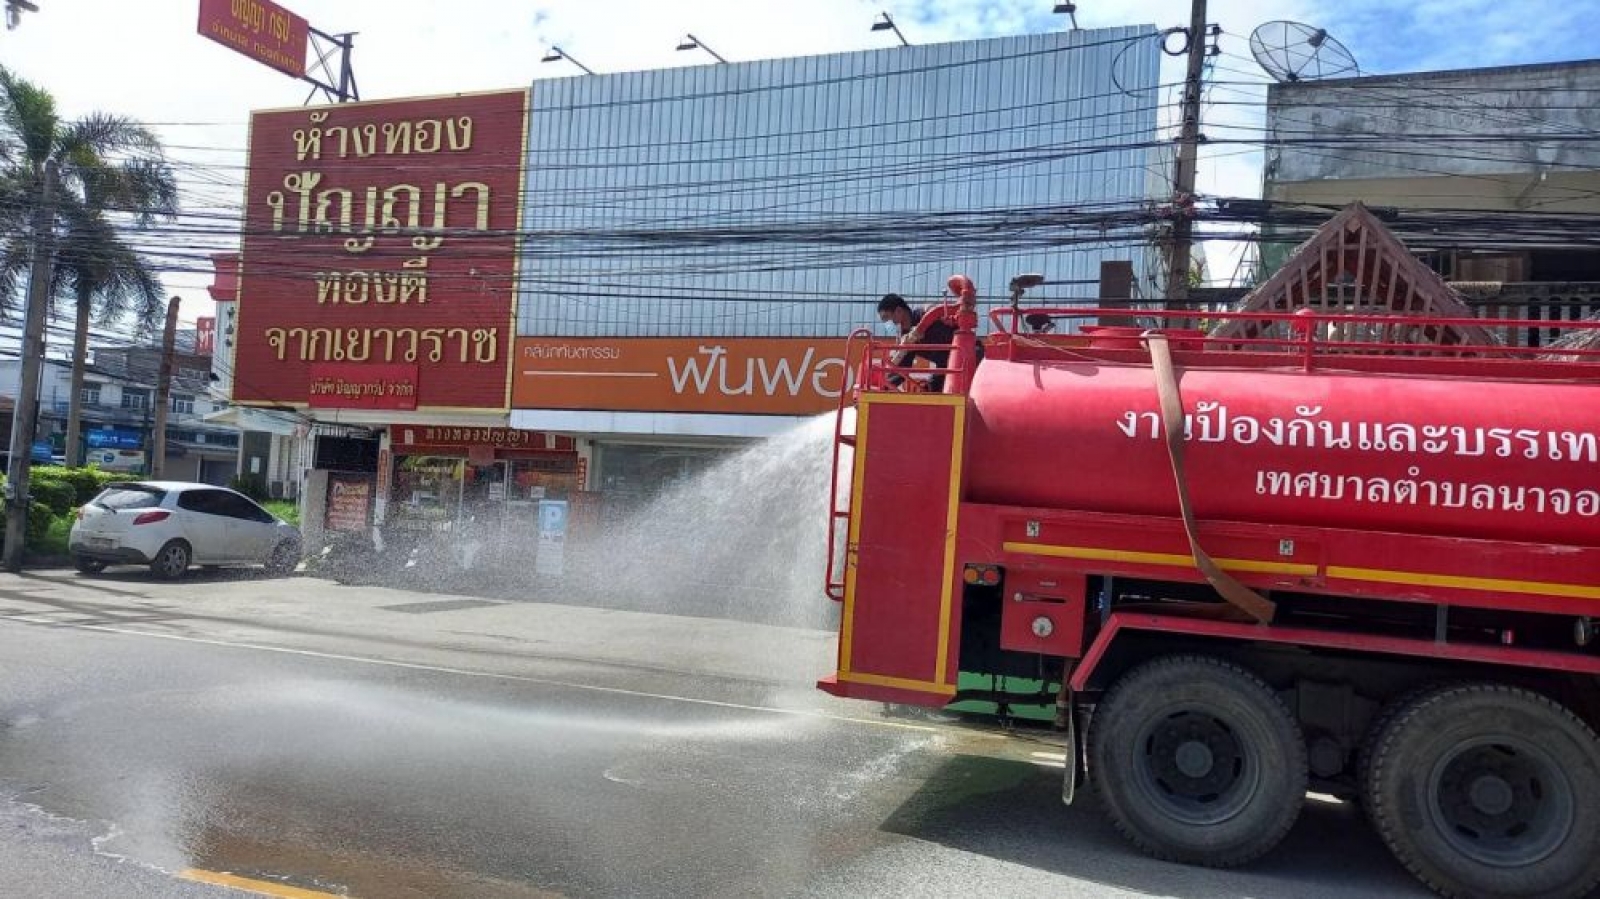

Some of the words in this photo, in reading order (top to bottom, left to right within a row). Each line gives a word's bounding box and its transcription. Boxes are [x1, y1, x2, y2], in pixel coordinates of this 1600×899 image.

[293, 112, 473, 161] ห้างทอง
[266, 171, 490, 252] ปัญญา
[313, 256, 429, 304] ทองดี
[265, 326, 498, 363] จากเยาวราช
[666, 345, 937, 398] ฟันฟอ
[1255, 466, 1600, 517] เทศบาลตำบลนาจอ
